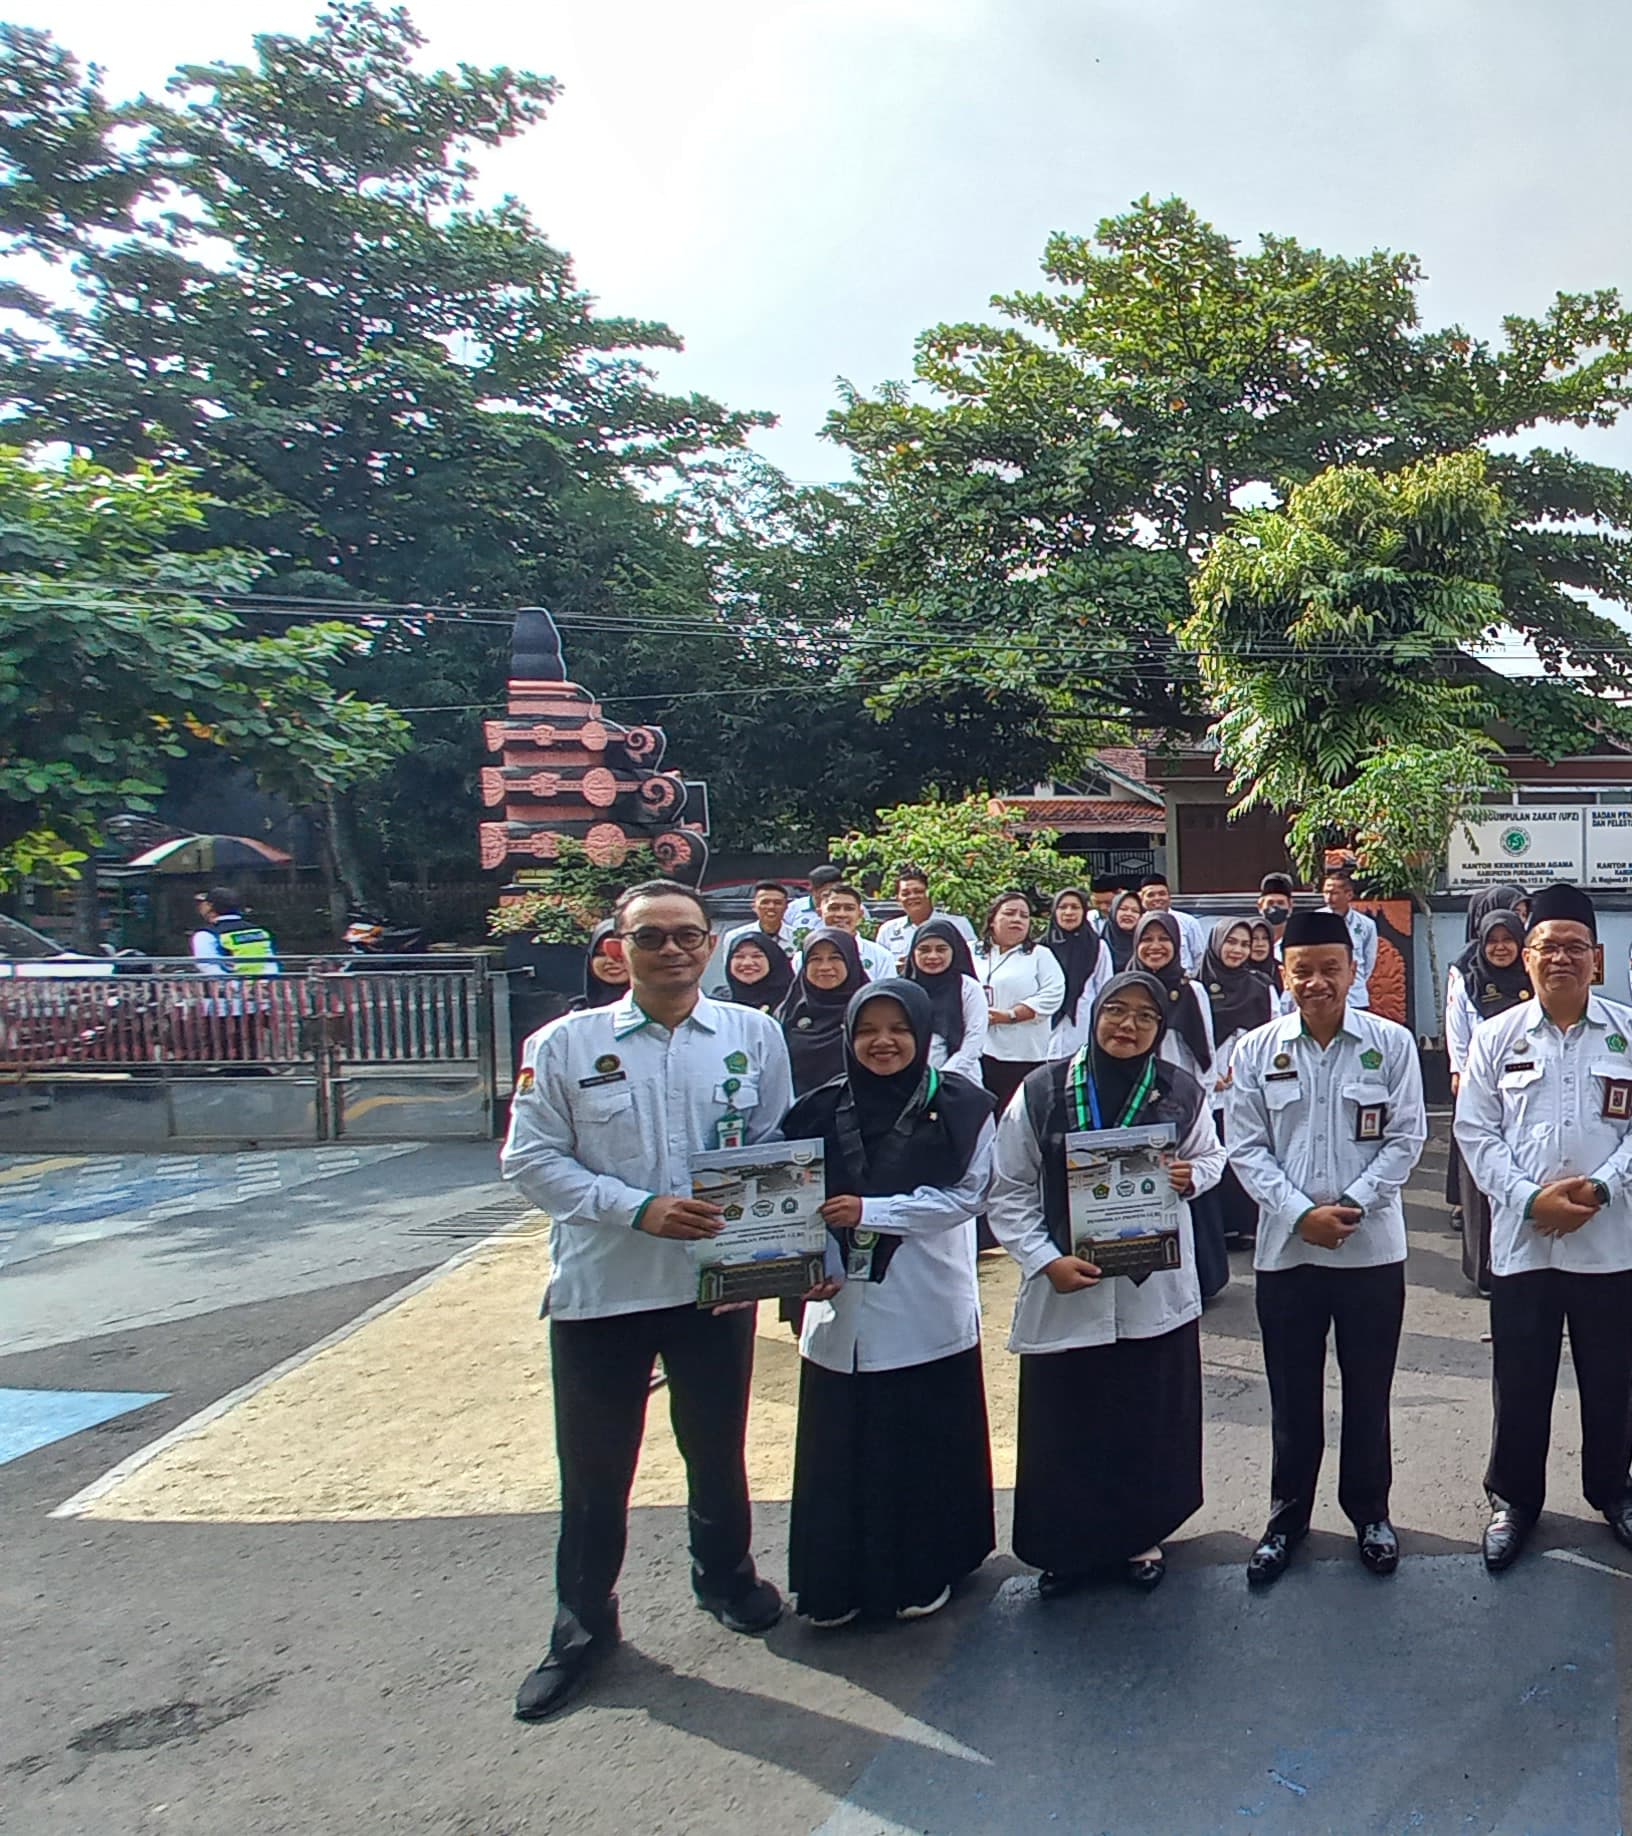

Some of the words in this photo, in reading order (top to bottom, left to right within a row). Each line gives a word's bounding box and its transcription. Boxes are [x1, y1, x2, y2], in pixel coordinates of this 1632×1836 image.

[1532, 812, 1557, 821] ZAKAT
[1592, 811, 1616, 819] BADAN
[1592, 819, 1606, 827] DAN
